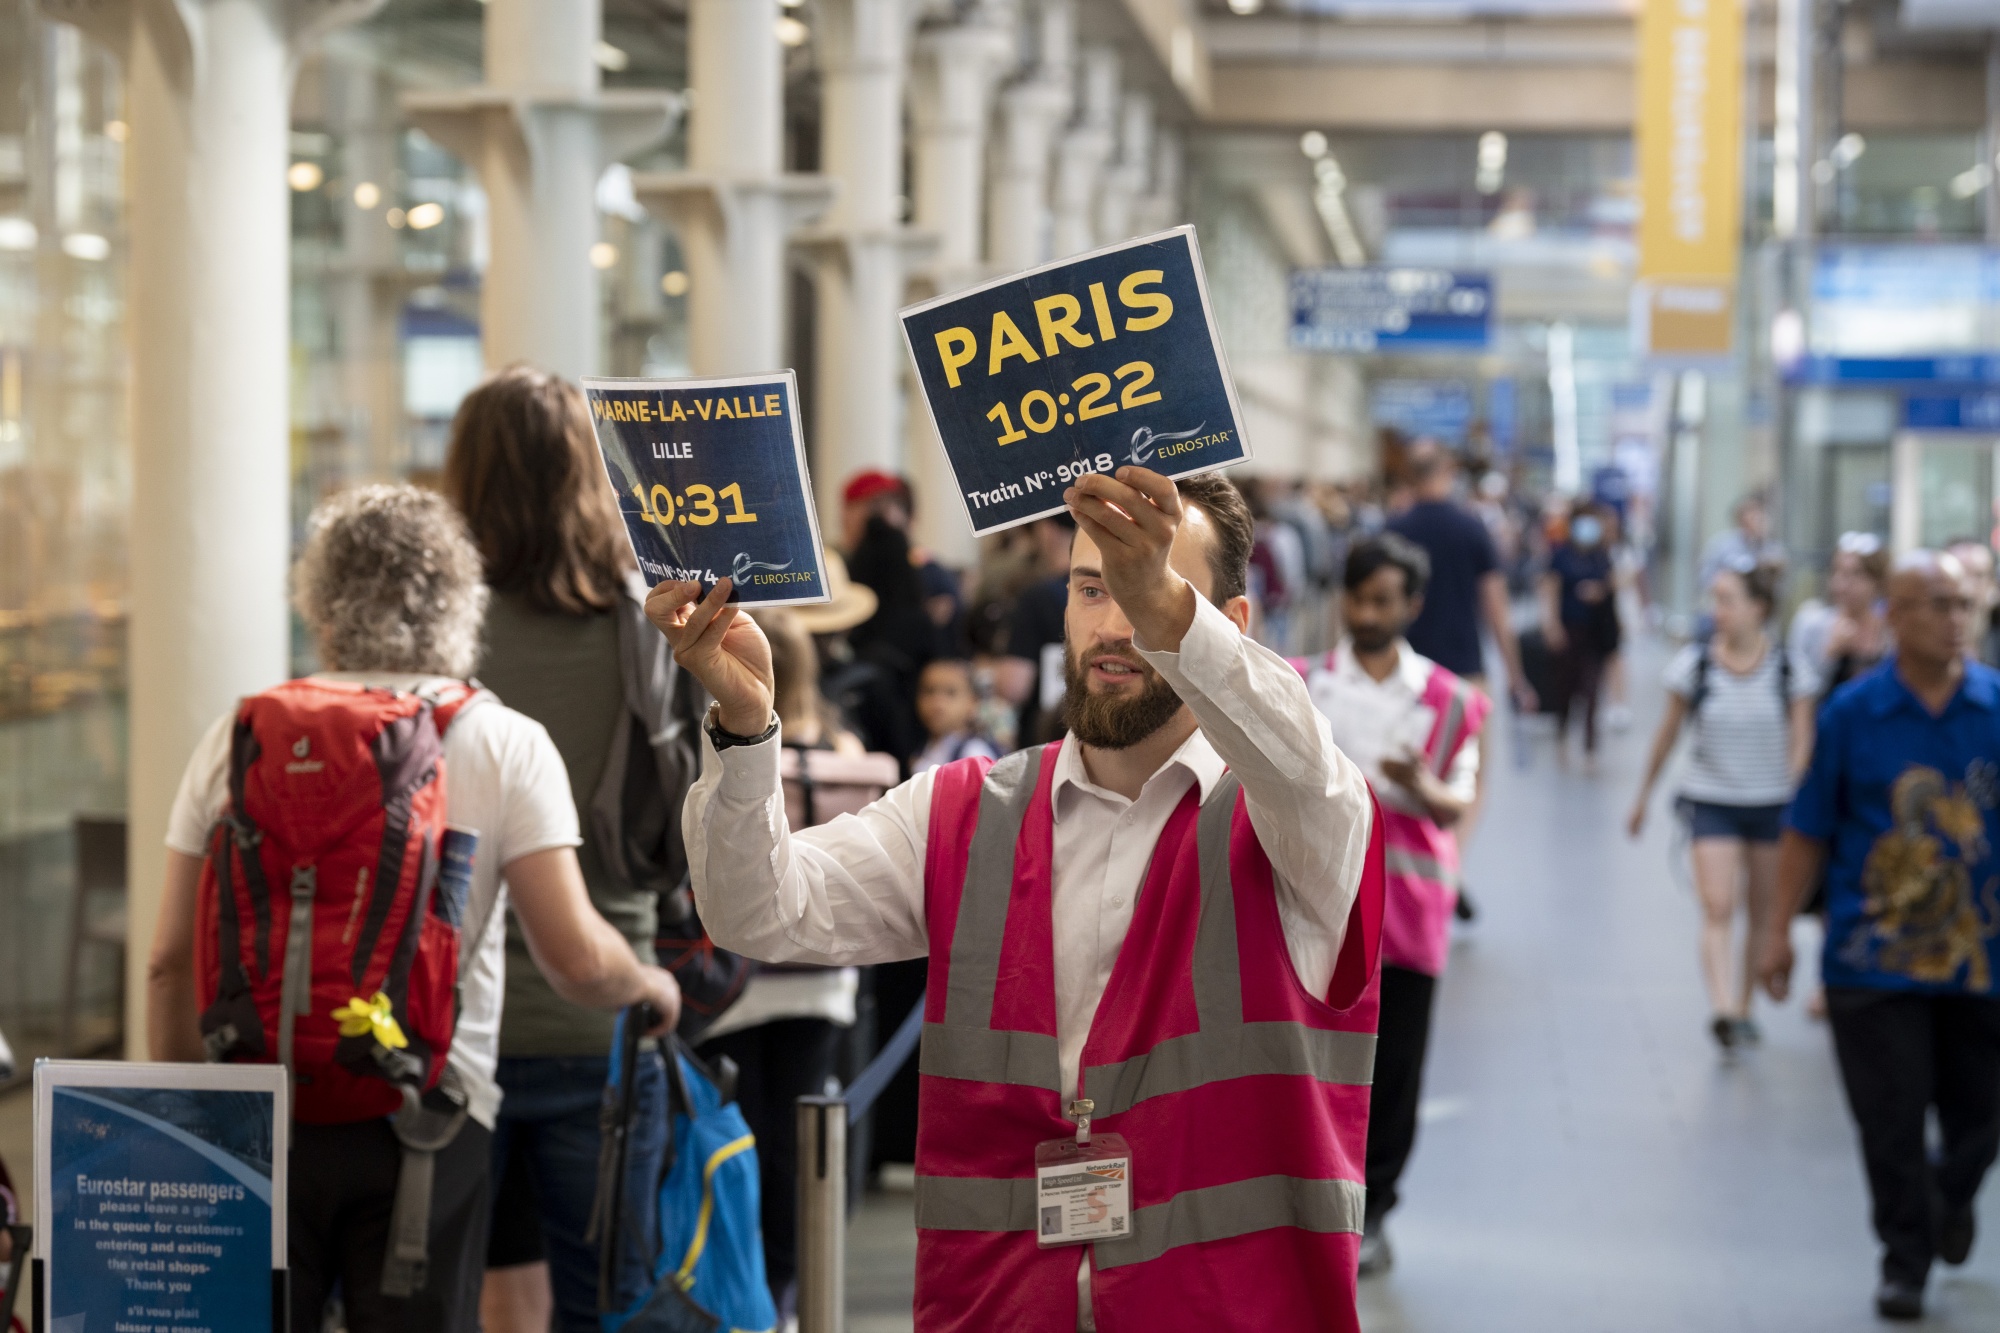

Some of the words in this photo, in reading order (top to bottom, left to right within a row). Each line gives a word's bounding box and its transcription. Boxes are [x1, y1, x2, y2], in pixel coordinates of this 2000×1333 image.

[934, 269, 1174, 388] PARIS
[592, 394, 782, 422] MARNE-LA-VALLE
[986, 360, 1162, 446] 10:22
[652, 442, 693, 458] LILLE
[968, 482, 1023, 510] Train
[1057, 452, 1114, 482] 9018
[632, 482, 758, 526] 10:31
[639, 556, 665, 576] Train
[676, 568, 719, 585] 9074
[77, 1174, 146, 1195] Eurostar
[151, 1182, 245, 1204] passengers
[100, 1201, 141, 1213] please
[144, 1202, 178, 1213] leave
[182, 1205, 190, 1214] a
[74, 1218, 85, 1229] in
[90, 1219, 109, 1230] the
[113, 1222, 151, 1233] queue
[154, 1222, 172, 1233] for
[176, 1223, 243, 1235] customers
[96, 1240, 147, 1254] entering
[151, 1241, 174, 1252] and
[178, 1242, 222, 1258] exiting
[108, 1258, 128, 1270] the
[131, 1260, 164, 1271] retail
[125, 1278, 164, 1291] Thank
[169, 1282, 191, 1293] you
[147, 1308, 171, 1318] vous
[116, 1322, 152, 1333] laisser
[155, 1324, 168, 1333] un
